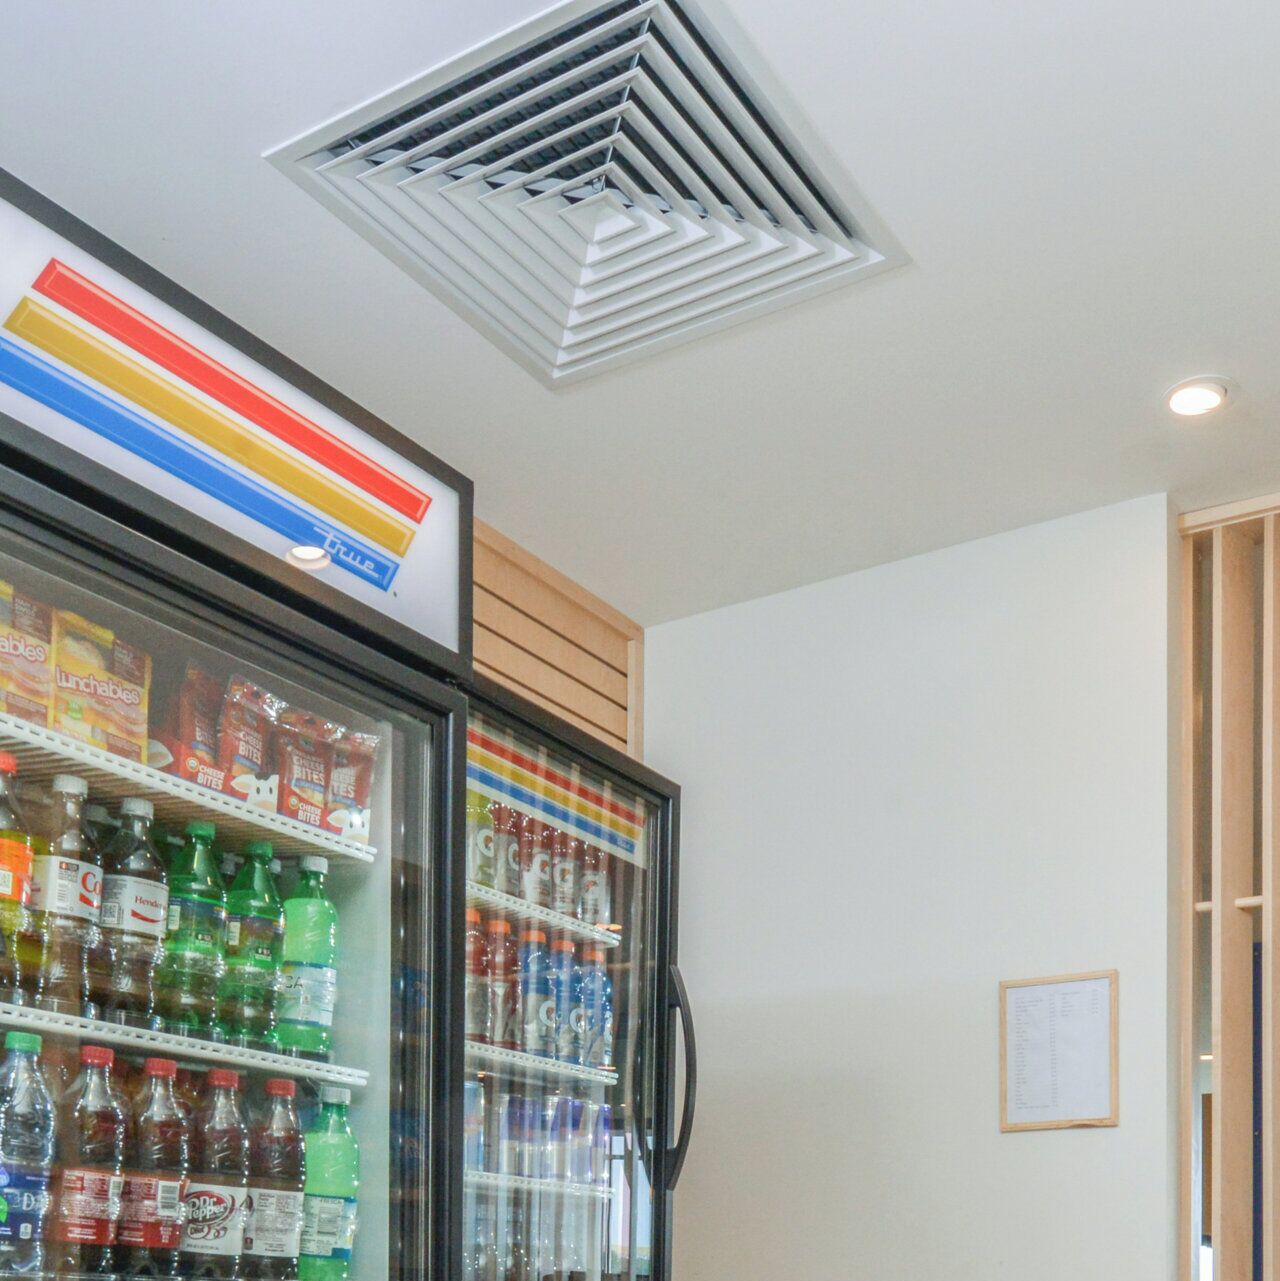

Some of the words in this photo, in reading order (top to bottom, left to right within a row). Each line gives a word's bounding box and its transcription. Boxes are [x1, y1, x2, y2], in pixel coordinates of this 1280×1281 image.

[239, 741, 263, 766] BITES
[198, 764, 225, 780] CHEESE
[293, 765, 325, 786] BITES
[197, 774, 224, 791] BITES
[297, 809, 321, 827] BITES
[298, 802, 322, 816] CHEESE
[187, 1199, 227, 1223] Pepper
